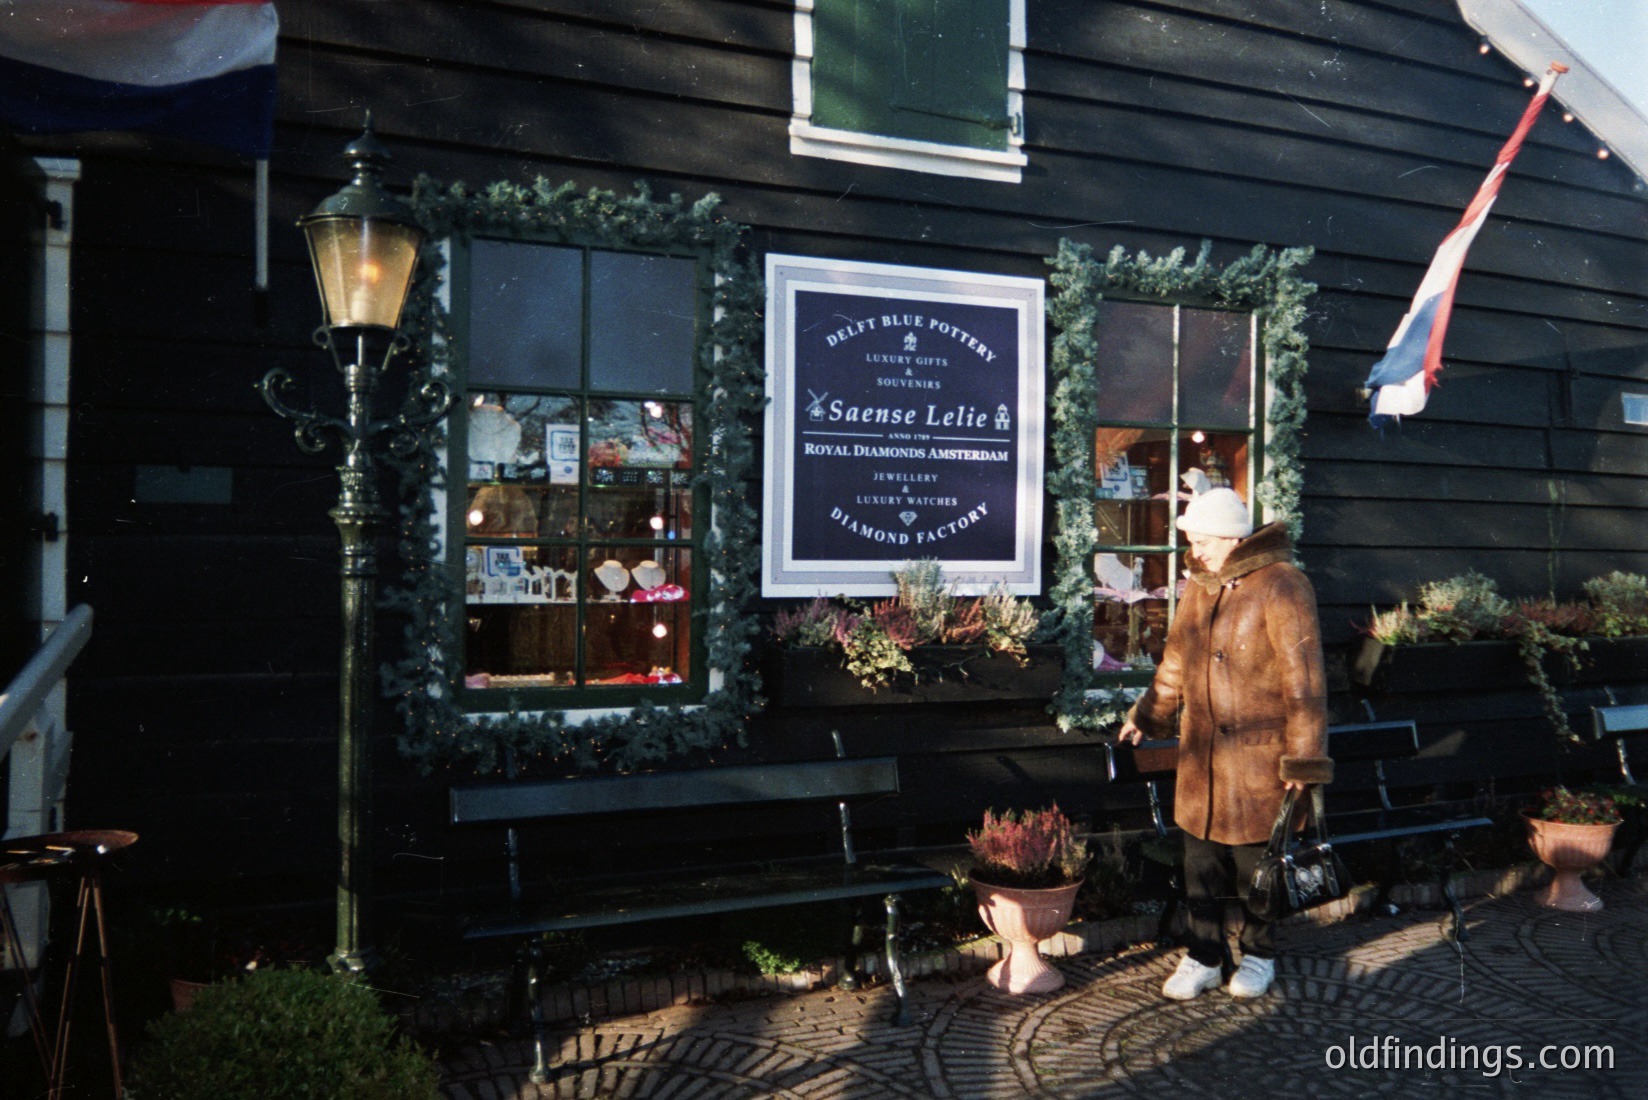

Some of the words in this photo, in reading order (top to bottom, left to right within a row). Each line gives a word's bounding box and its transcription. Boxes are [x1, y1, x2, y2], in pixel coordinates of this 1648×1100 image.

[826, 317, 875, 347] DELFT
[881, 314, 923, 328] BLUE
[929, 318, 997, 364] POTTERY
[866, 353, 912, 365] LUXURY
[916, 357, 948, 367] GIFTS
[905, 368, 913, 377] &
[877, 378, 941, 390] SOUVENIRS
[829, 400, 916, 424] Saense
[925, 405, 987, 428] Lelie
[804, 442, 851, 456] ROYAL
[853, 444, 926, 459] DIAMONDS
[928, 448, 1008, 462] AMSTERDAM
[873, 472, 938, 483] JEWELLERY
[902, 485, 910, 493] &
[857, 495, 902, 505] LUXURY
[907, 497, 958, 507] WATCHES
[830, 507, 909, 545] DIAMOND
[917, 502, 989, 544] FACTORY
